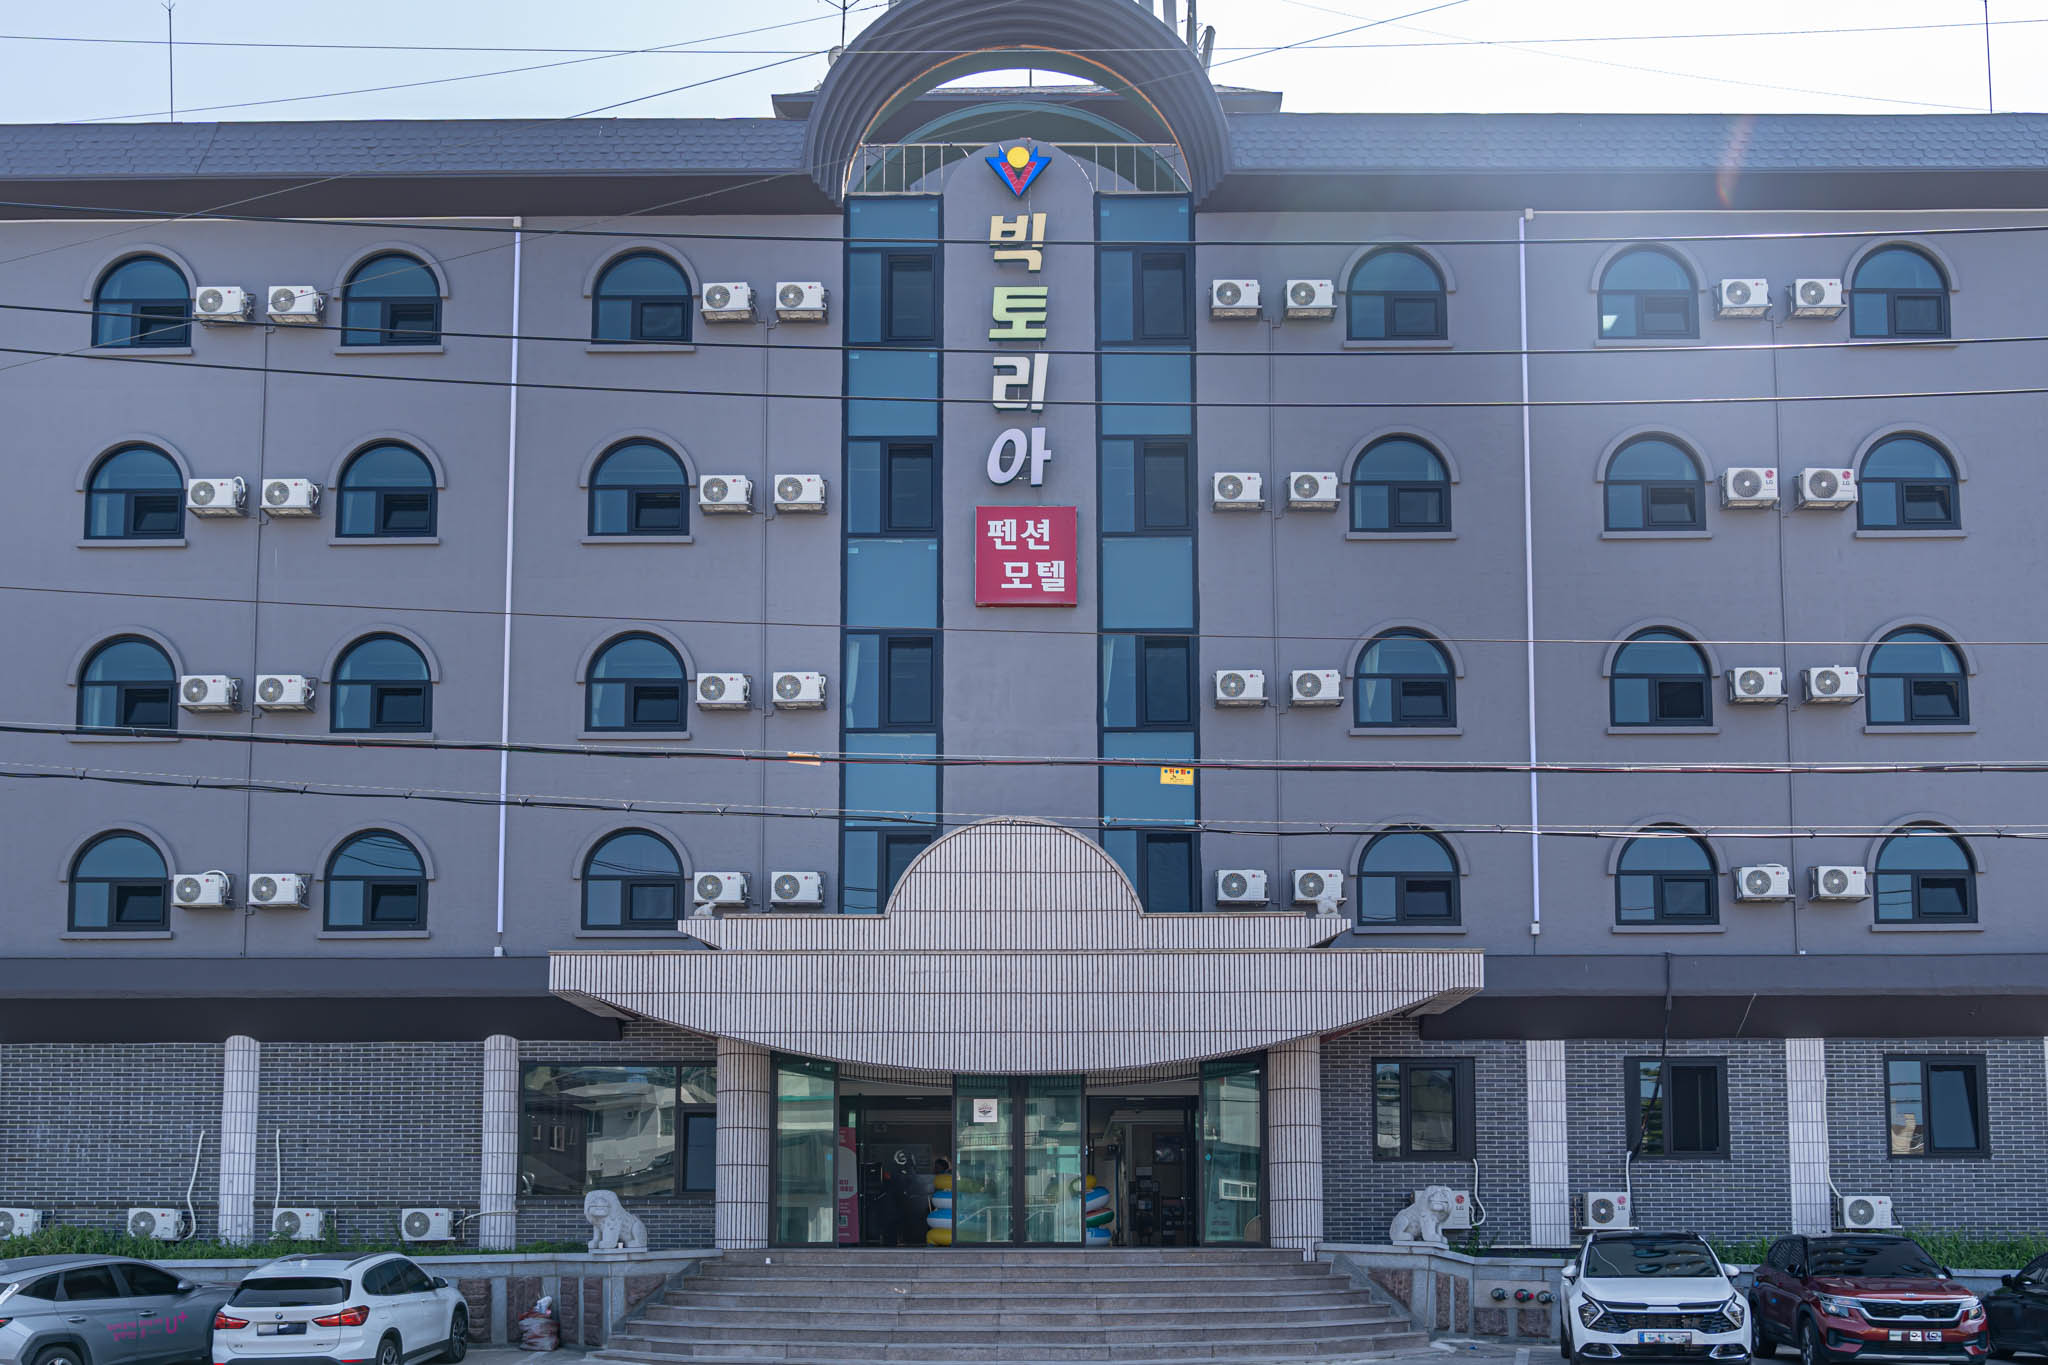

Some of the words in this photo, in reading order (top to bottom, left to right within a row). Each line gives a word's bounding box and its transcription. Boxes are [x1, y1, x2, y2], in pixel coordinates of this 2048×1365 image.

[988, 212, 1052, 487] 빅토리아
[987, 519, 1050, 550] 펜션
[1001, 560, 1065, 592] 모텔
